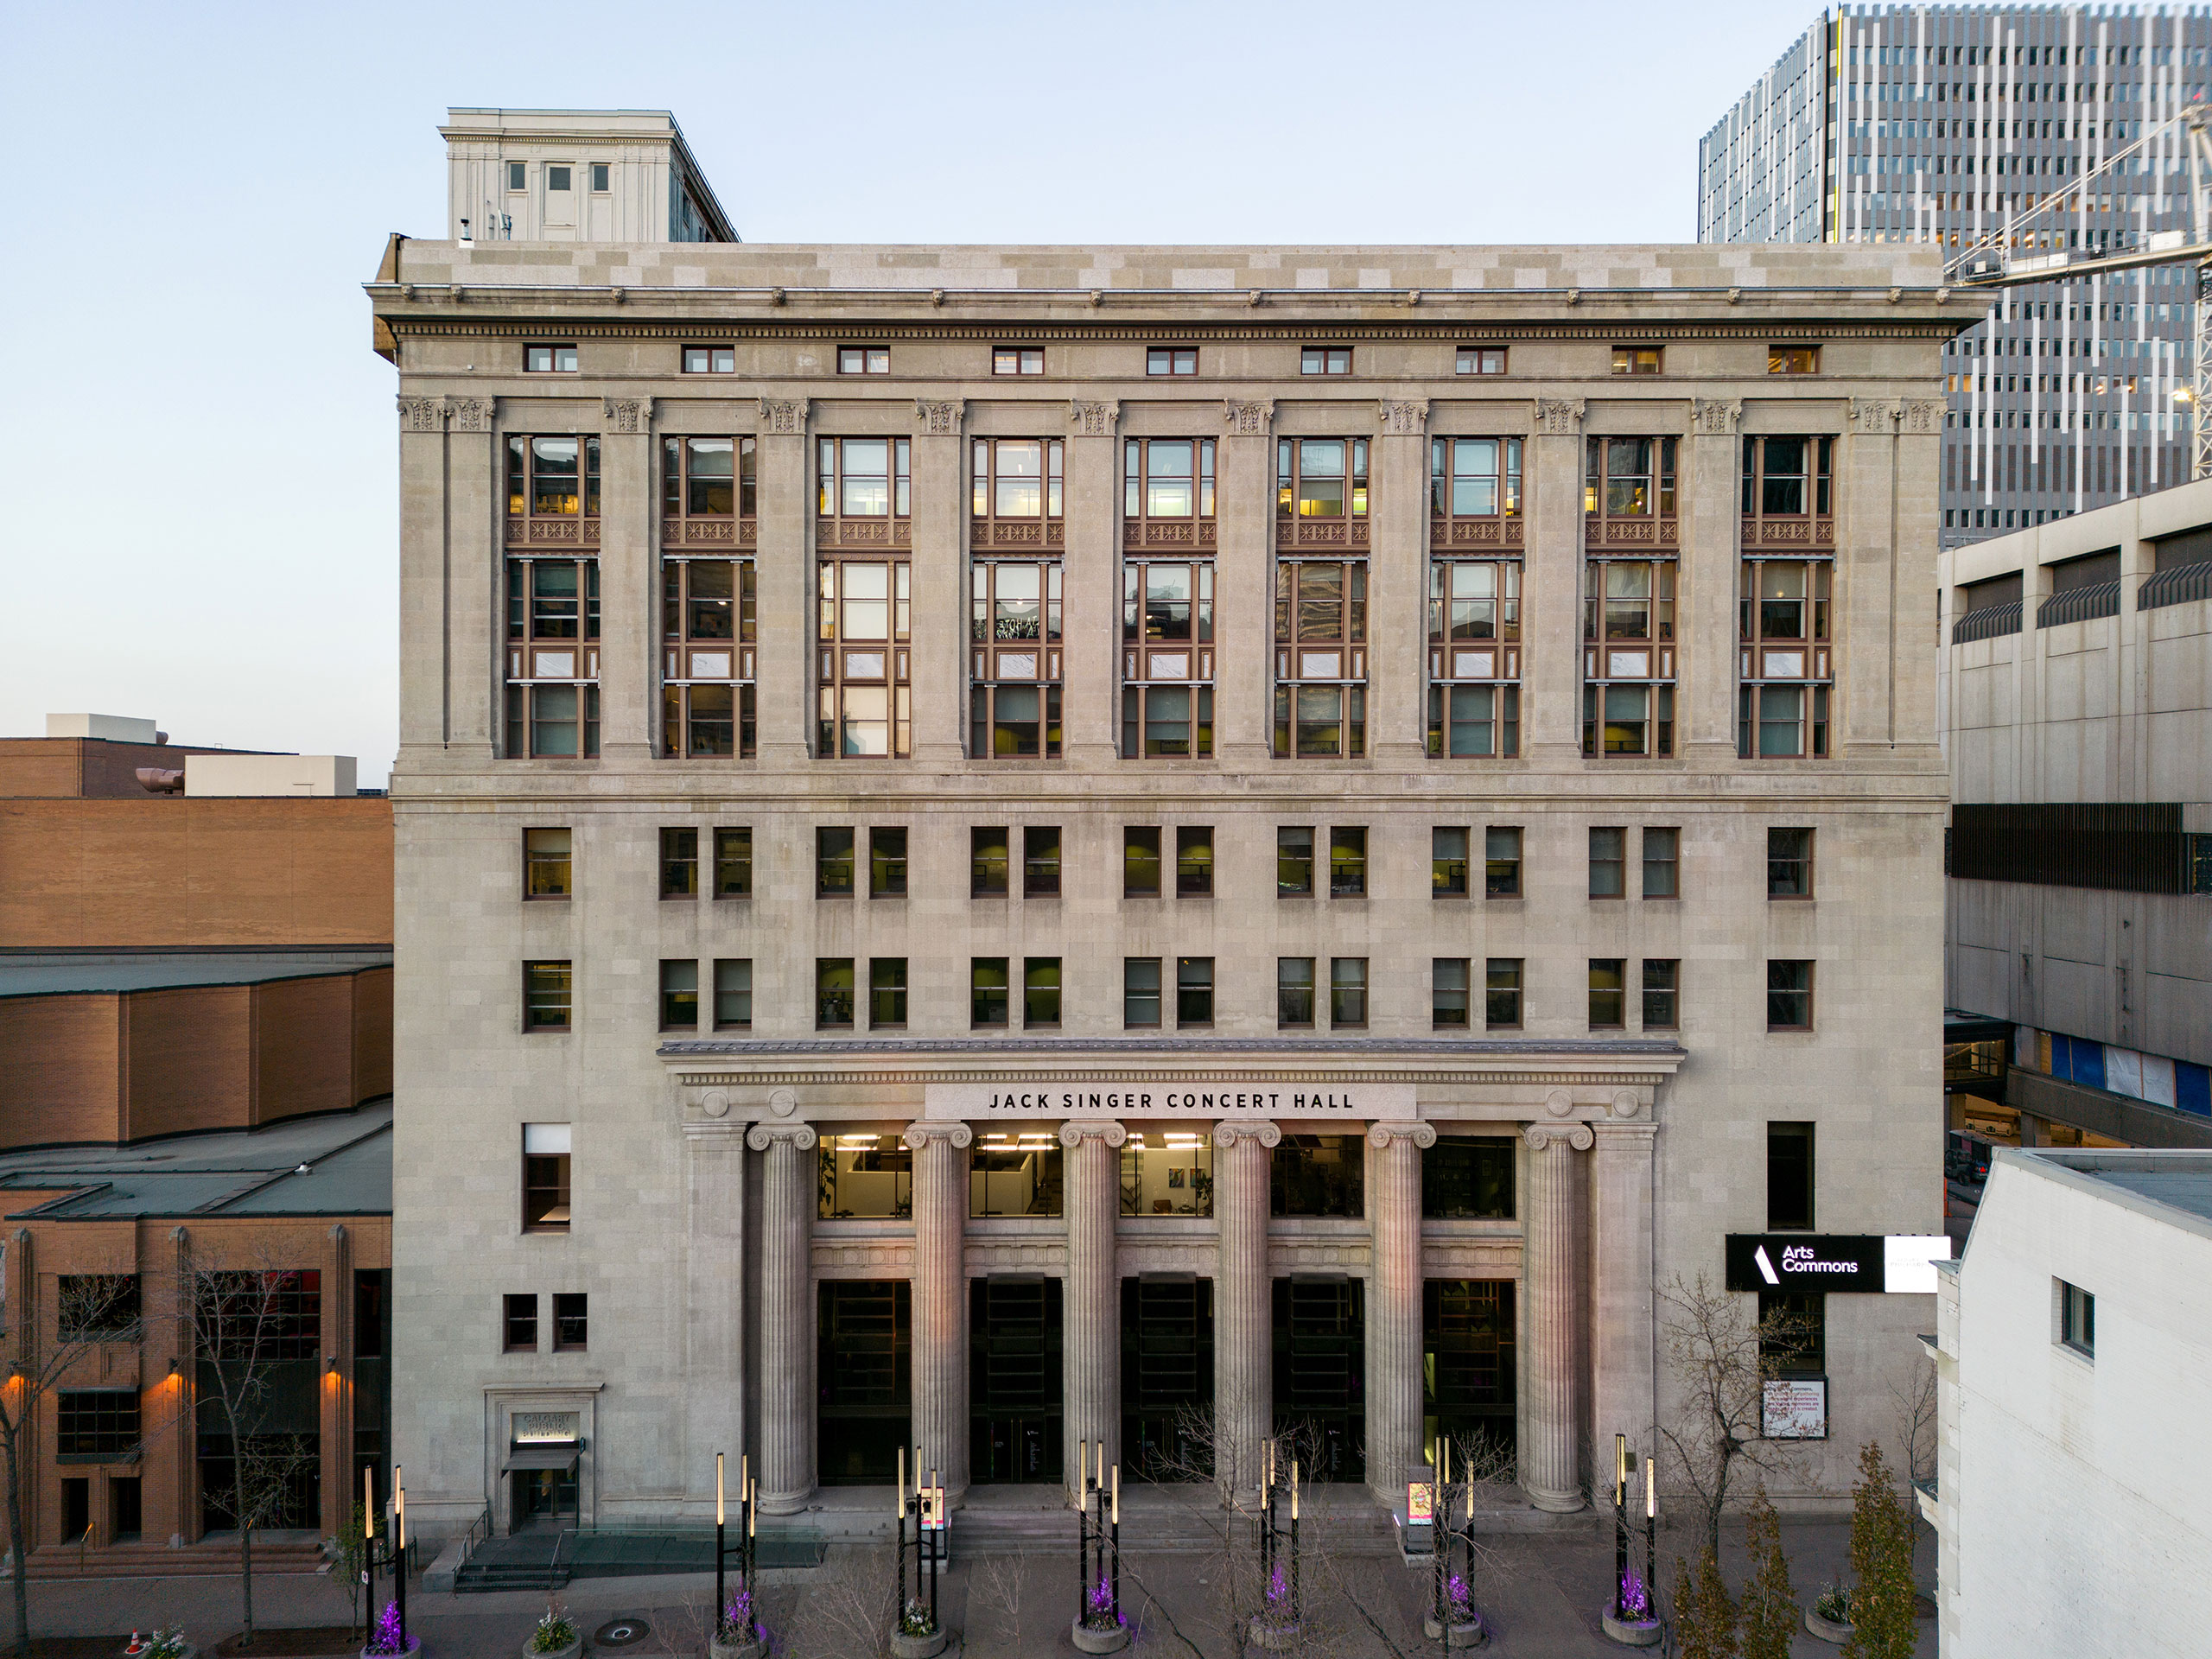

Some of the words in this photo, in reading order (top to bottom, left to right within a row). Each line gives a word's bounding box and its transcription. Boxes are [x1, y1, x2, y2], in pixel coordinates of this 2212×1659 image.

[989, 1094, 1049, 1109] JACK
[1063, 1094, 1152, 1108] SINGER
[1166, 1093, 1279, 1109] CONCERT
[1294, 1094, 1353, 1108] HALL
[1783, 1245, 1815, 1259] Arts
[1783, 1258, 1859, 1273] Commons
[524, 1414, 569, 1423] CALGARY
[528, 1422, 565, 1431] PUBLIC
